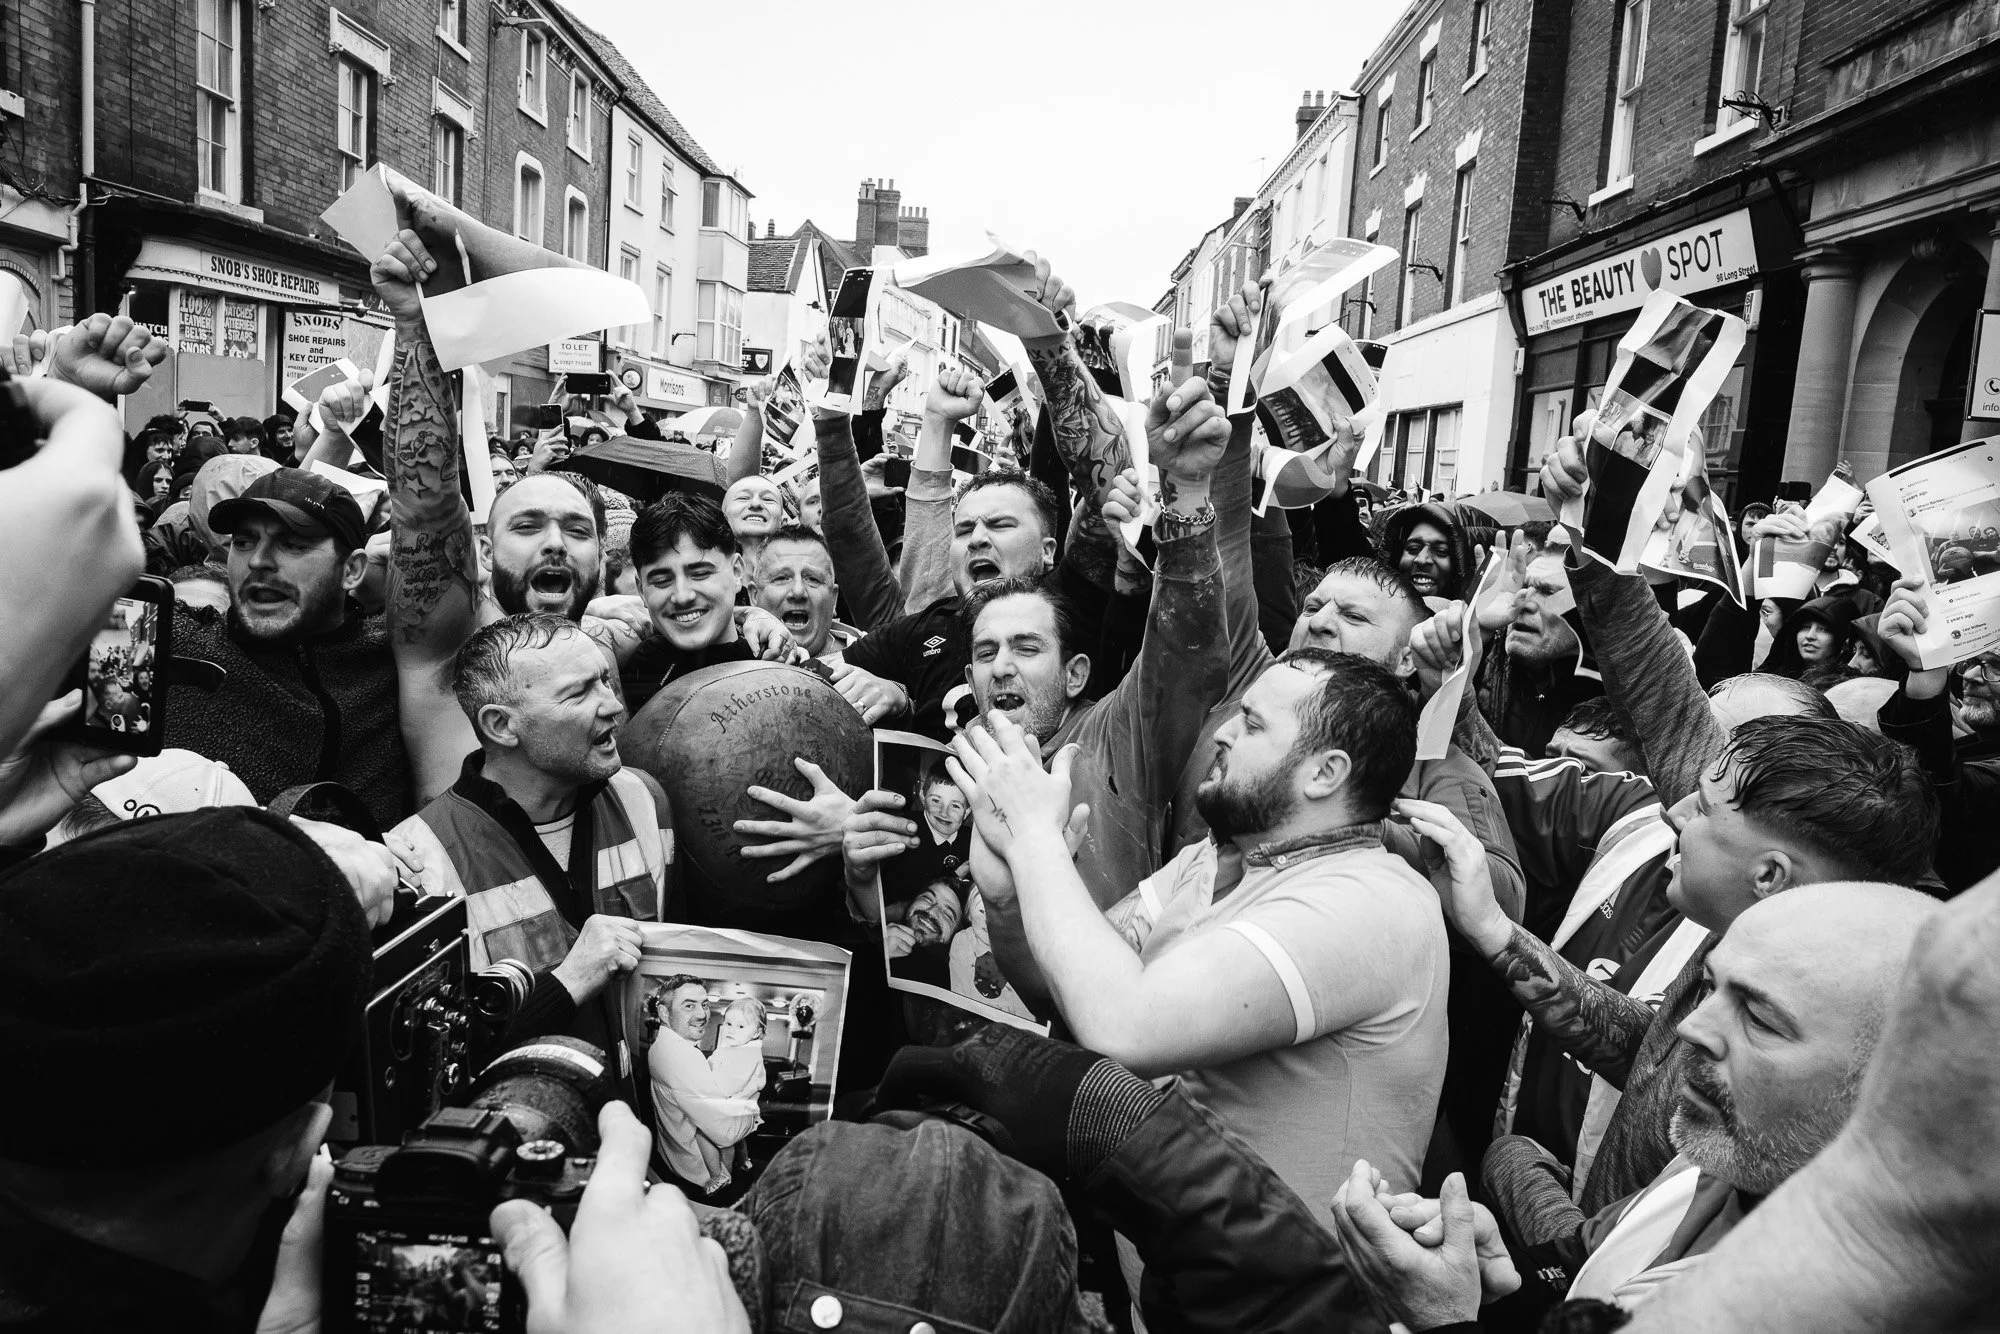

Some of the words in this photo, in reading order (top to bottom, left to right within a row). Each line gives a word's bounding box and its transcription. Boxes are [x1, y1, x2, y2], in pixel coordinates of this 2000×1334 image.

[211, 255, 250, 280] SNOB'S
[252, 266, 279, 287] SHOE
[281, 273, 320, 296] REPAIRS
[1538, 284, 1567, 318] THE
[1571, 259, 1635, 308] BEAUTY
[1667, 228, 1723, 281] SPOT
[1724, 269, 1738, 282] Long
[1738, 264, 1756, 277] Street
[180, 295, 213, 317] 100%
[180, 312, 212, 332] LEATHER
[224, 316, 255, 331] ATTERIES
[293, 312, 343, 331] SNOBS
[184, 326, 208, 341] BELTS
[228, 329, 253, 343] STRAPS
[288, 333, 310, 344] SHOE
[312, 336, 346, 347] REPAIRS
[289, 353, 306, 362] KEY
[307, 355, 342, 364] CUTTIN
[309, 346, 324, 354] and
[659, 378, 685, 397] Morrisons
[710, 683, 812, 734] Atherstone
